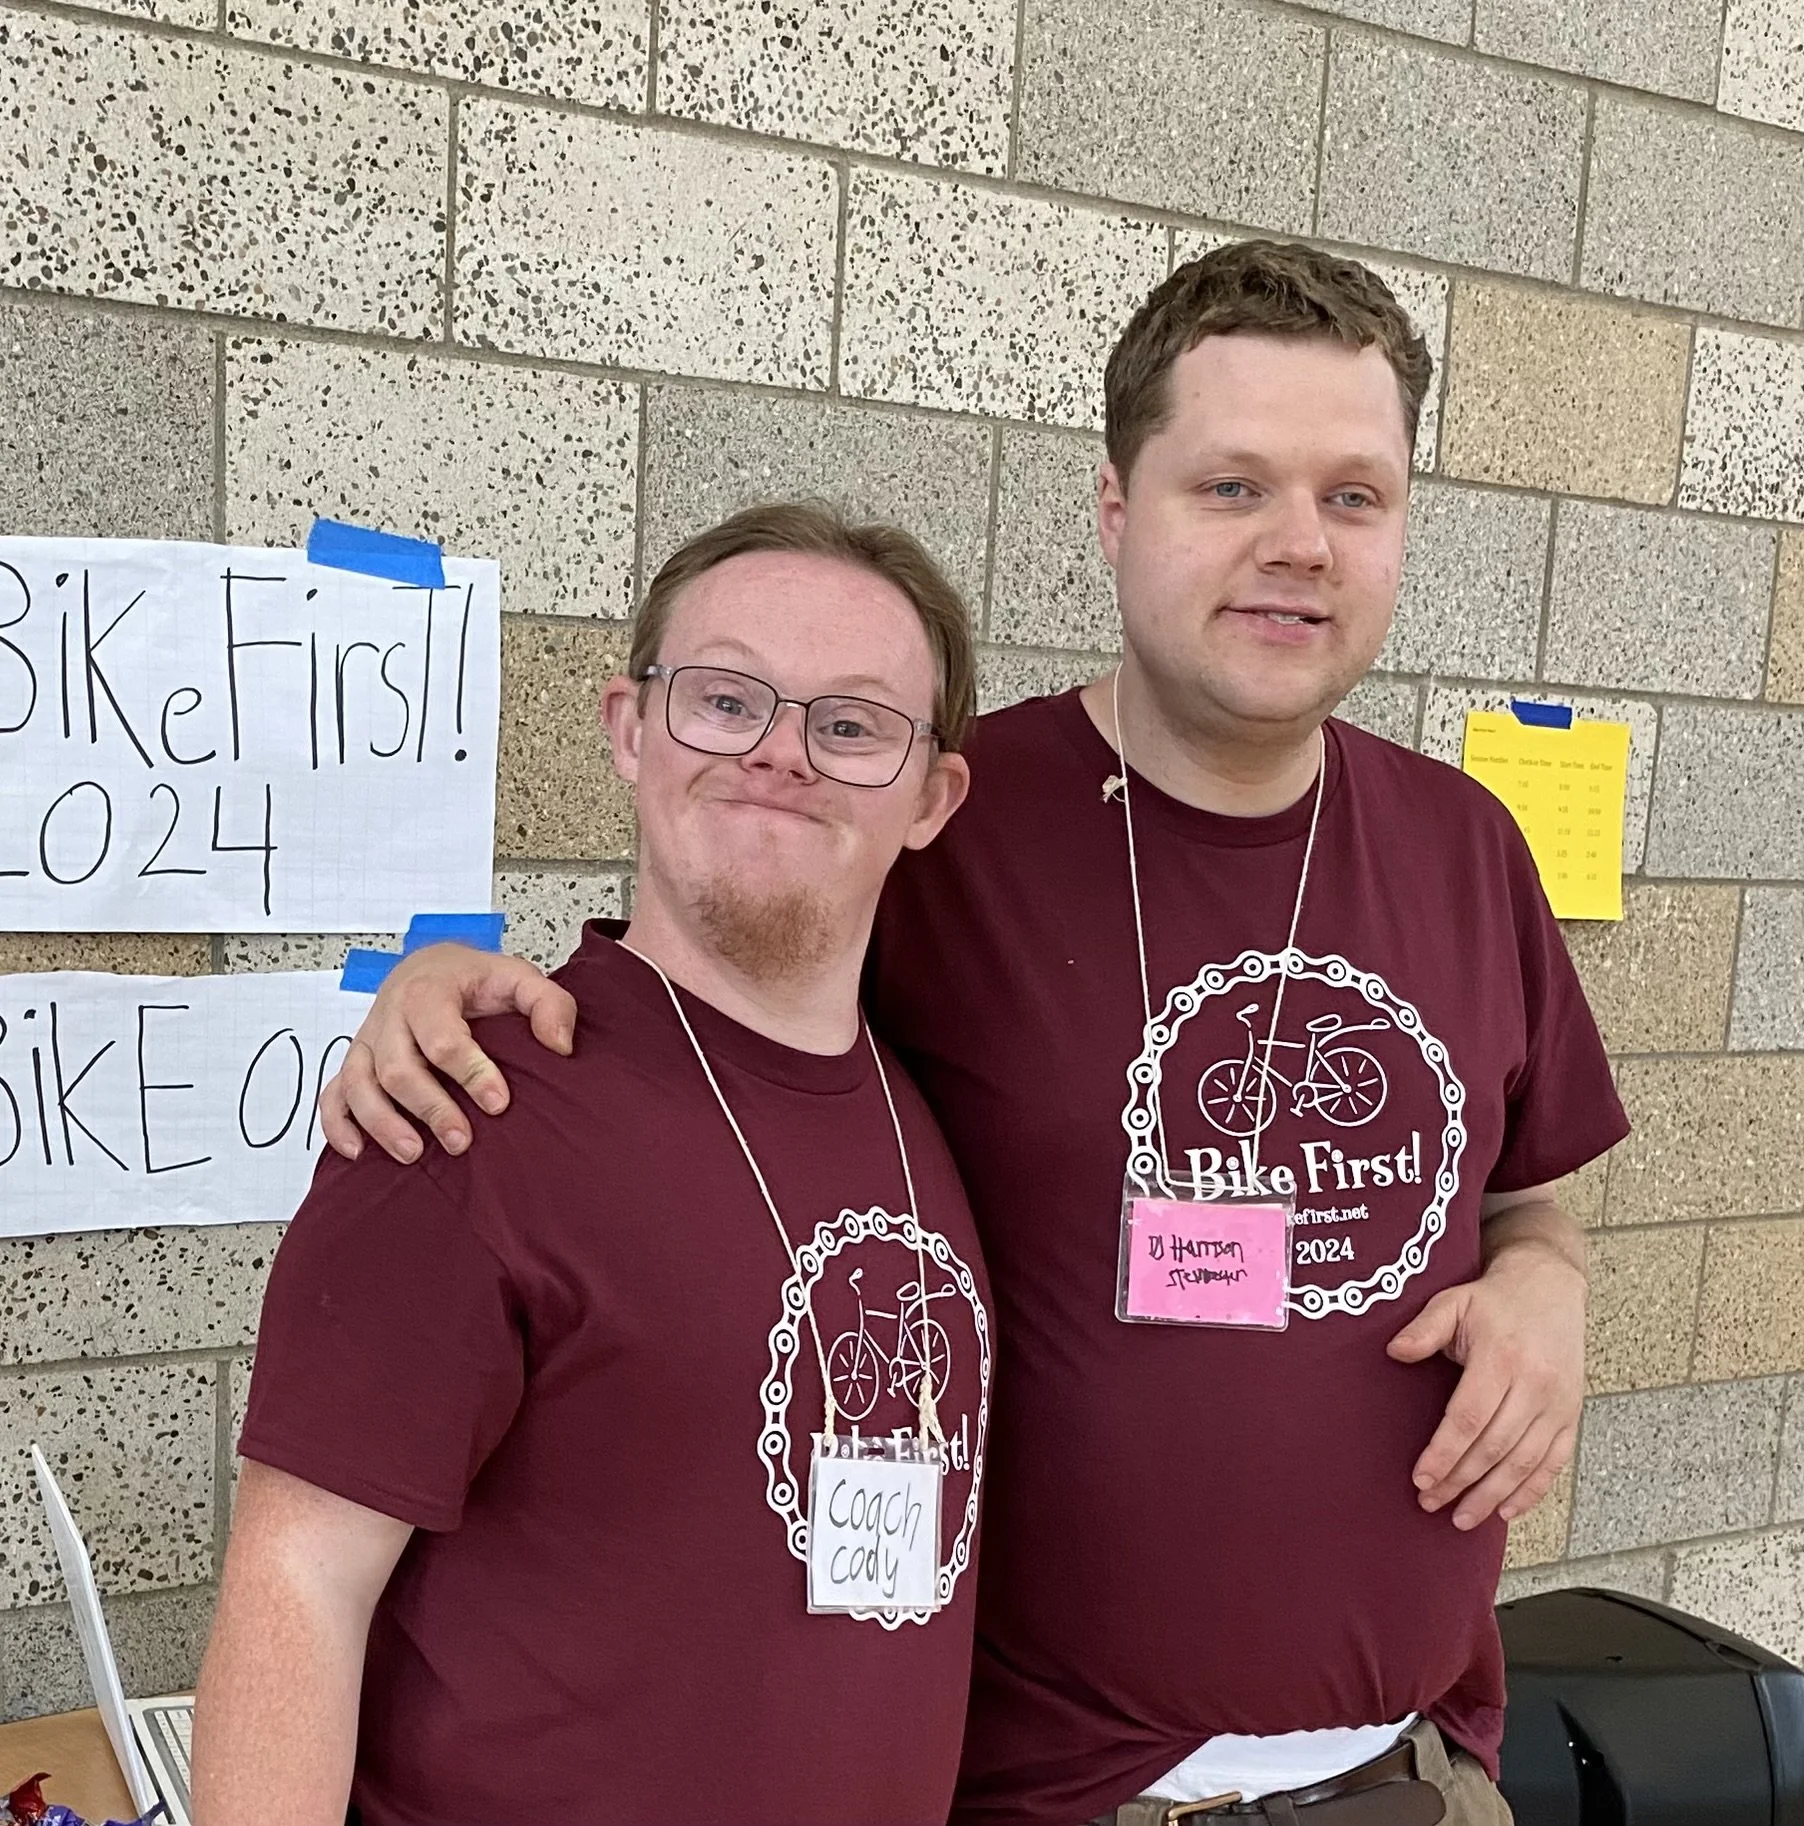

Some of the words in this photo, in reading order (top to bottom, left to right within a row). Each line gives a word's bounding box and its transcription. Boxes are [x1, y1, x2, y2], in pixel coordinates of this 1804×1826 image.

[1184, 1140, 1295, 1200] Bike
[1300, 1130, 1423, 1194] First!
[1296, 1237, 1355, 1265] 2024
